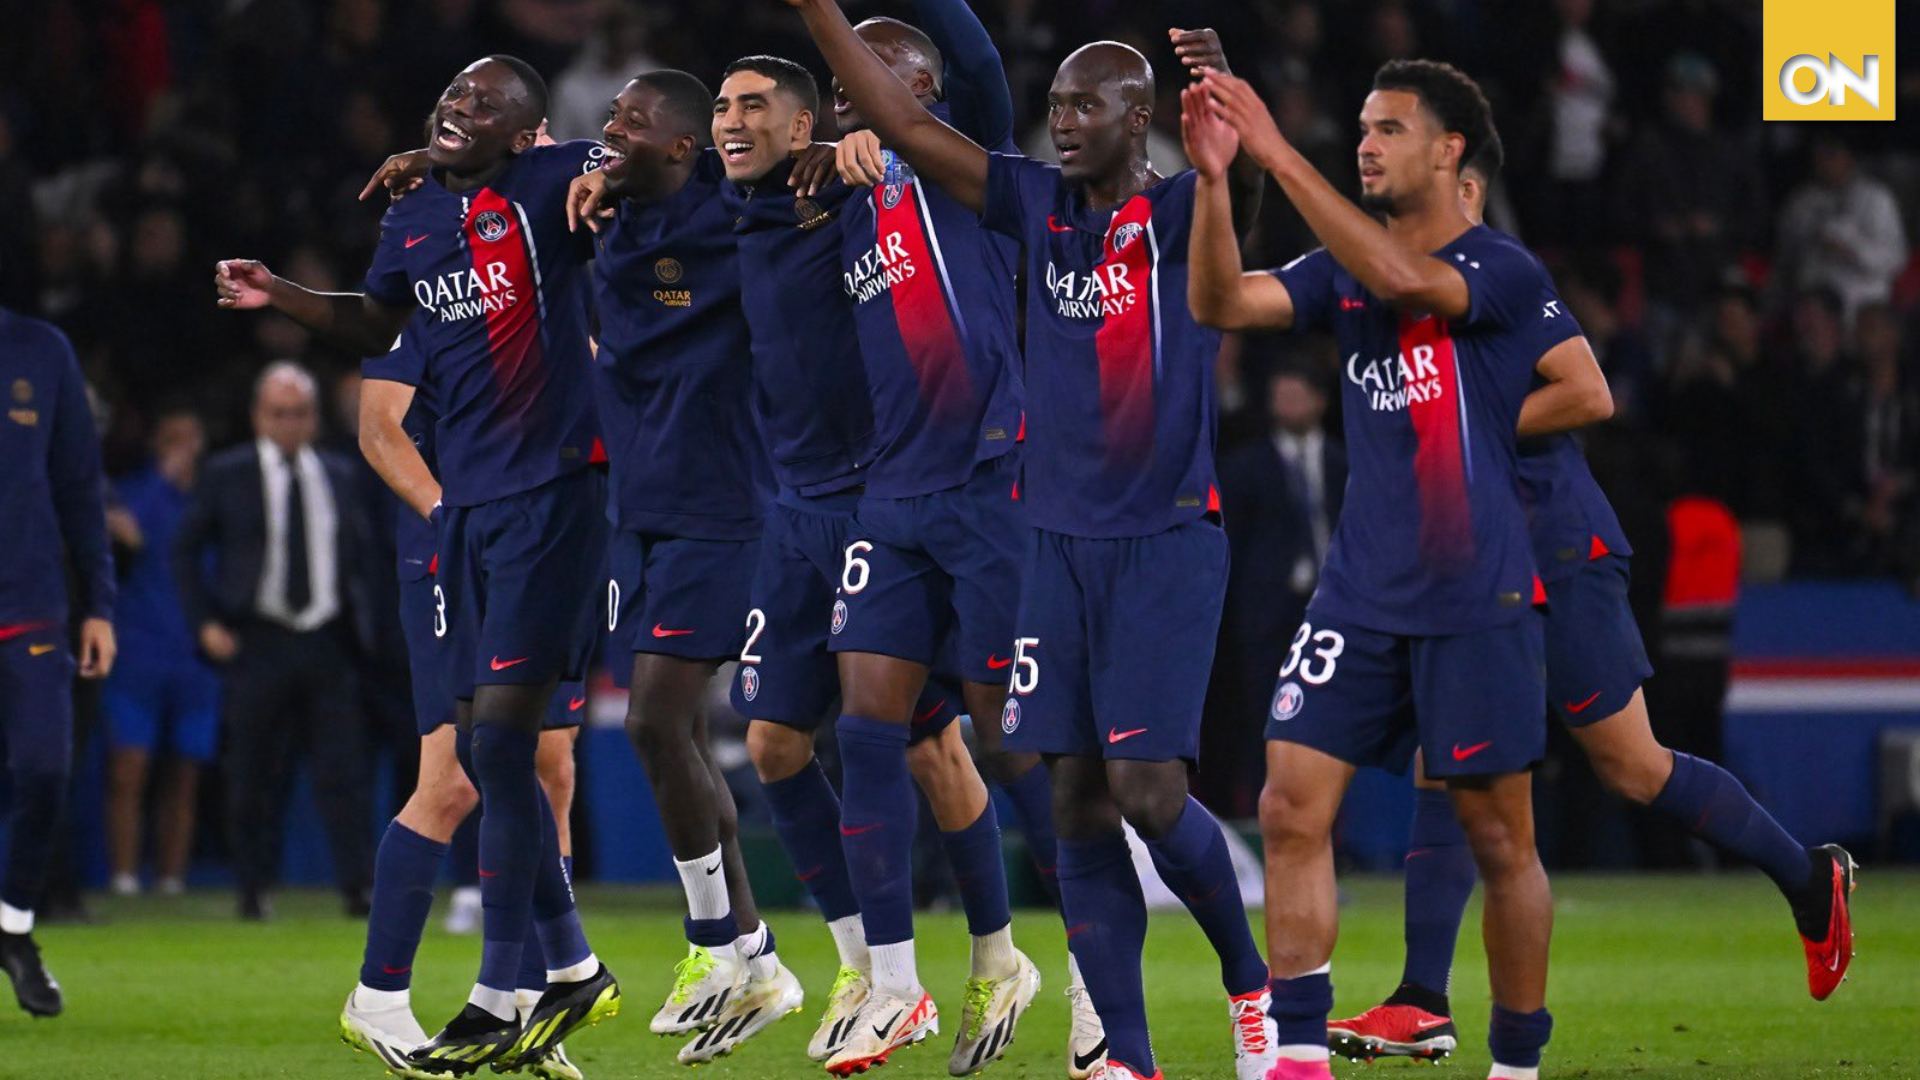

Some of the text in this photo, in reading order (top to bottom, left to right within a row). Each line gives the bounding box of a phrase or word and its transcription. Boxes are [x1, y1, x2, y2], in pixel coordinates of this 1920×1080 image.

[414, 261, 513, 313] QATAR
[844, 231, 910, 298] QATAR
[856, 259, 916, 304] AIRWAYS
[1046, 261, 1136, 301] QATAR
[440, 289, 518, 323] AIRWAYS
[653, 290, 691, 301] QATAR
[1368, 376, 1443, 412] IRWAYS
[836, 540, 874, 594] 6
[740, 608, 766, 664] 2
[1008, 637, 1039, 693] 15
